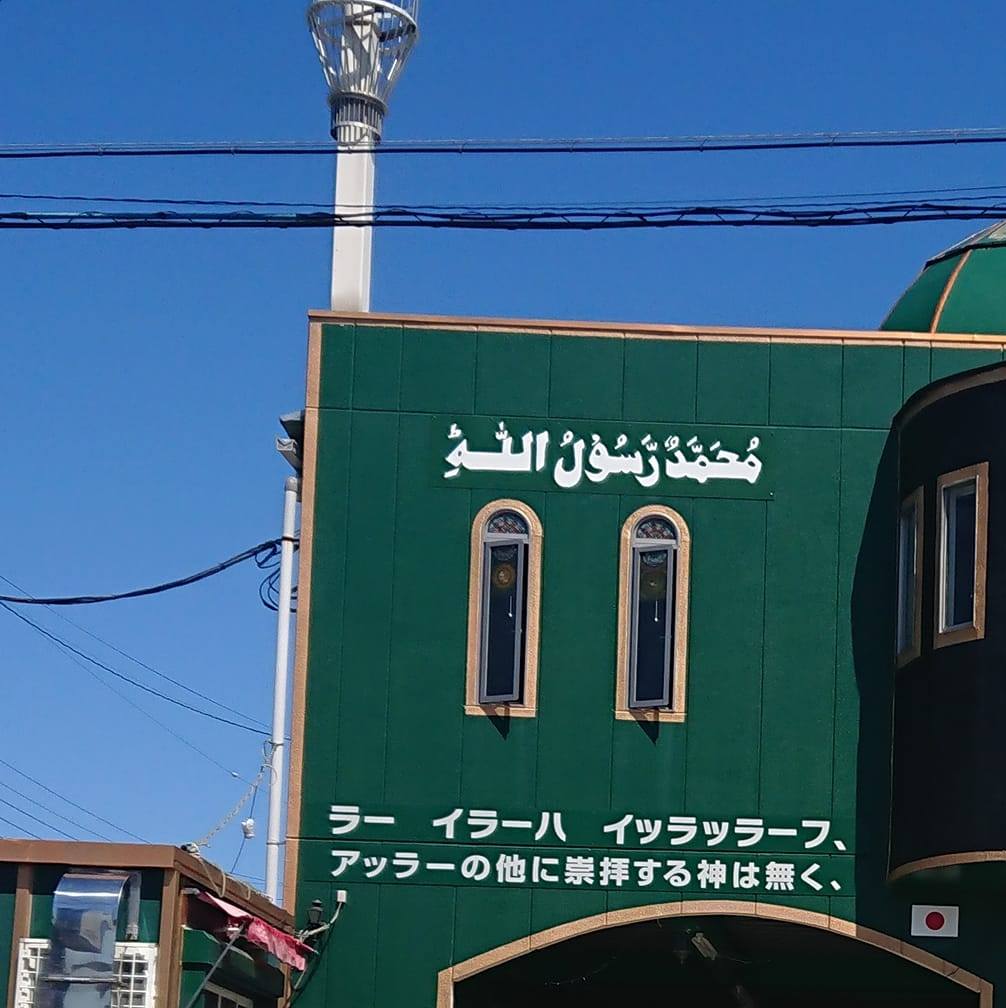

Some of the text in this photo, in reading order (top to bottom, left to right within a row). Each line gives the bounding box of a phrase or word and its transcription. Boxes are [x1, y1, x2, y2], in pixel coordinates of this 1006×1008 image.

[329, 805, 847, 851] ラー イラーハ イッラッラーフ、
[331, 850, 842, 892] アッラーの他に崇拝する神は無く、
